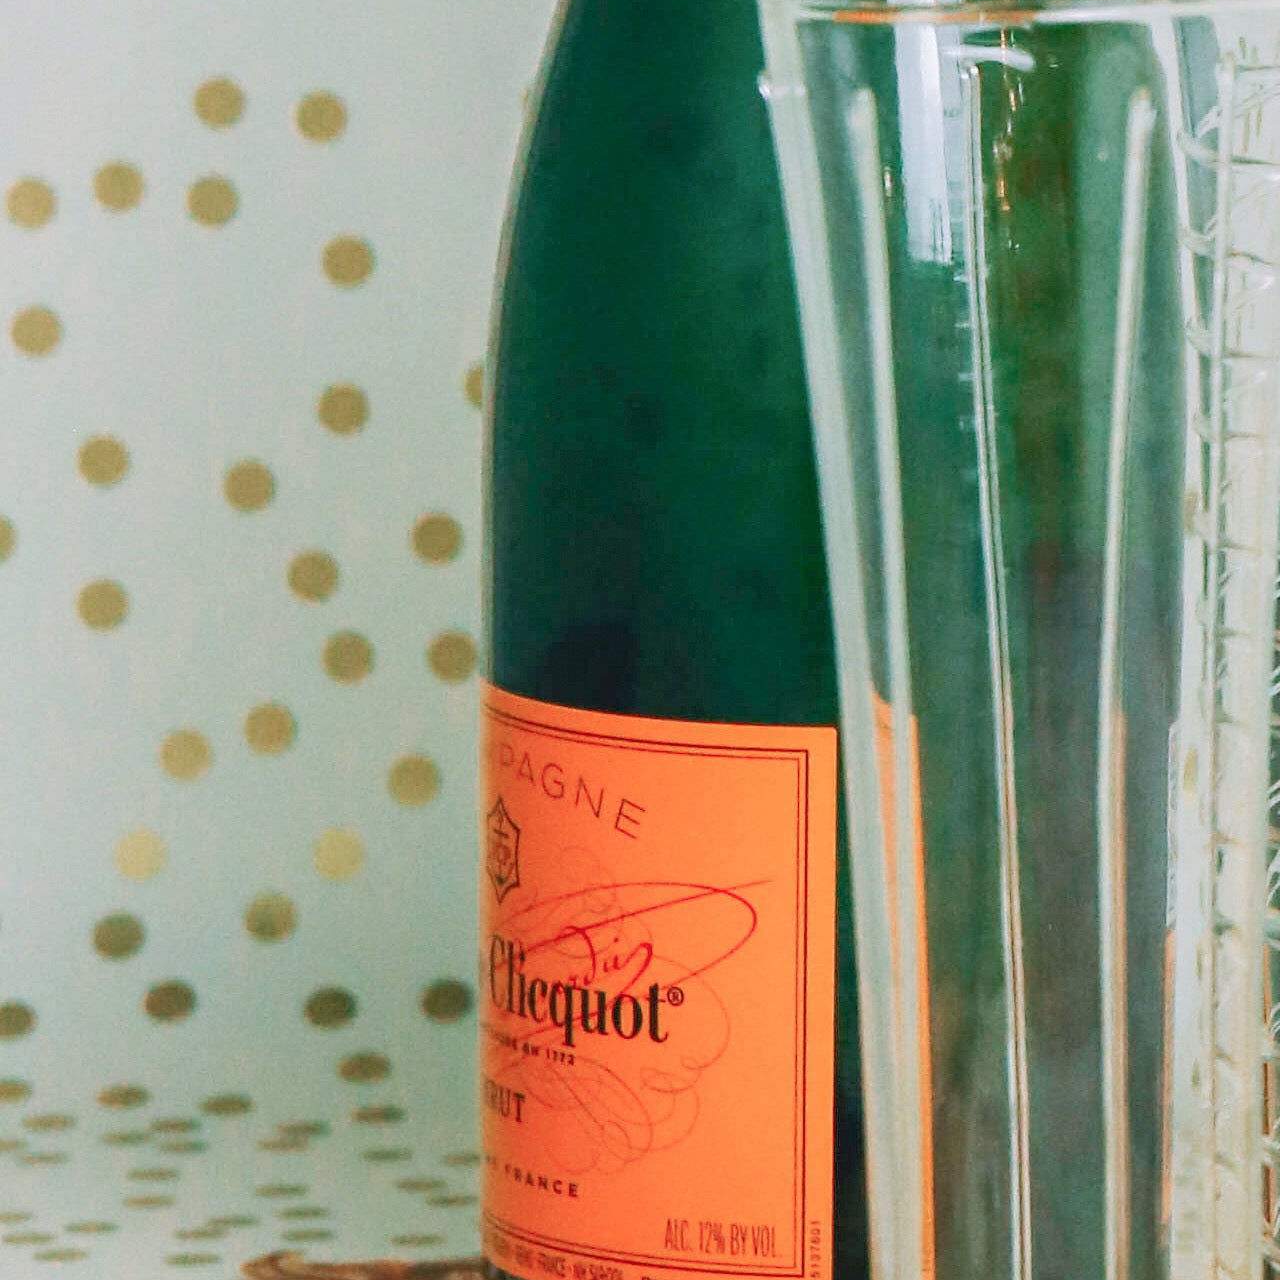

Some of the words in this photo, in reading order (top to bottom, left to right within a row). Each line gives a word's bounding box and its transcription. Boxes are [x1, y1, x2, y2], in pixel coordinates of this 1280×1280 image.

[504, 1163, 579, 1198] FRANCE
[699, 1220, 726, 1255] 12%
[730, 1223, 749, 1257] BY
